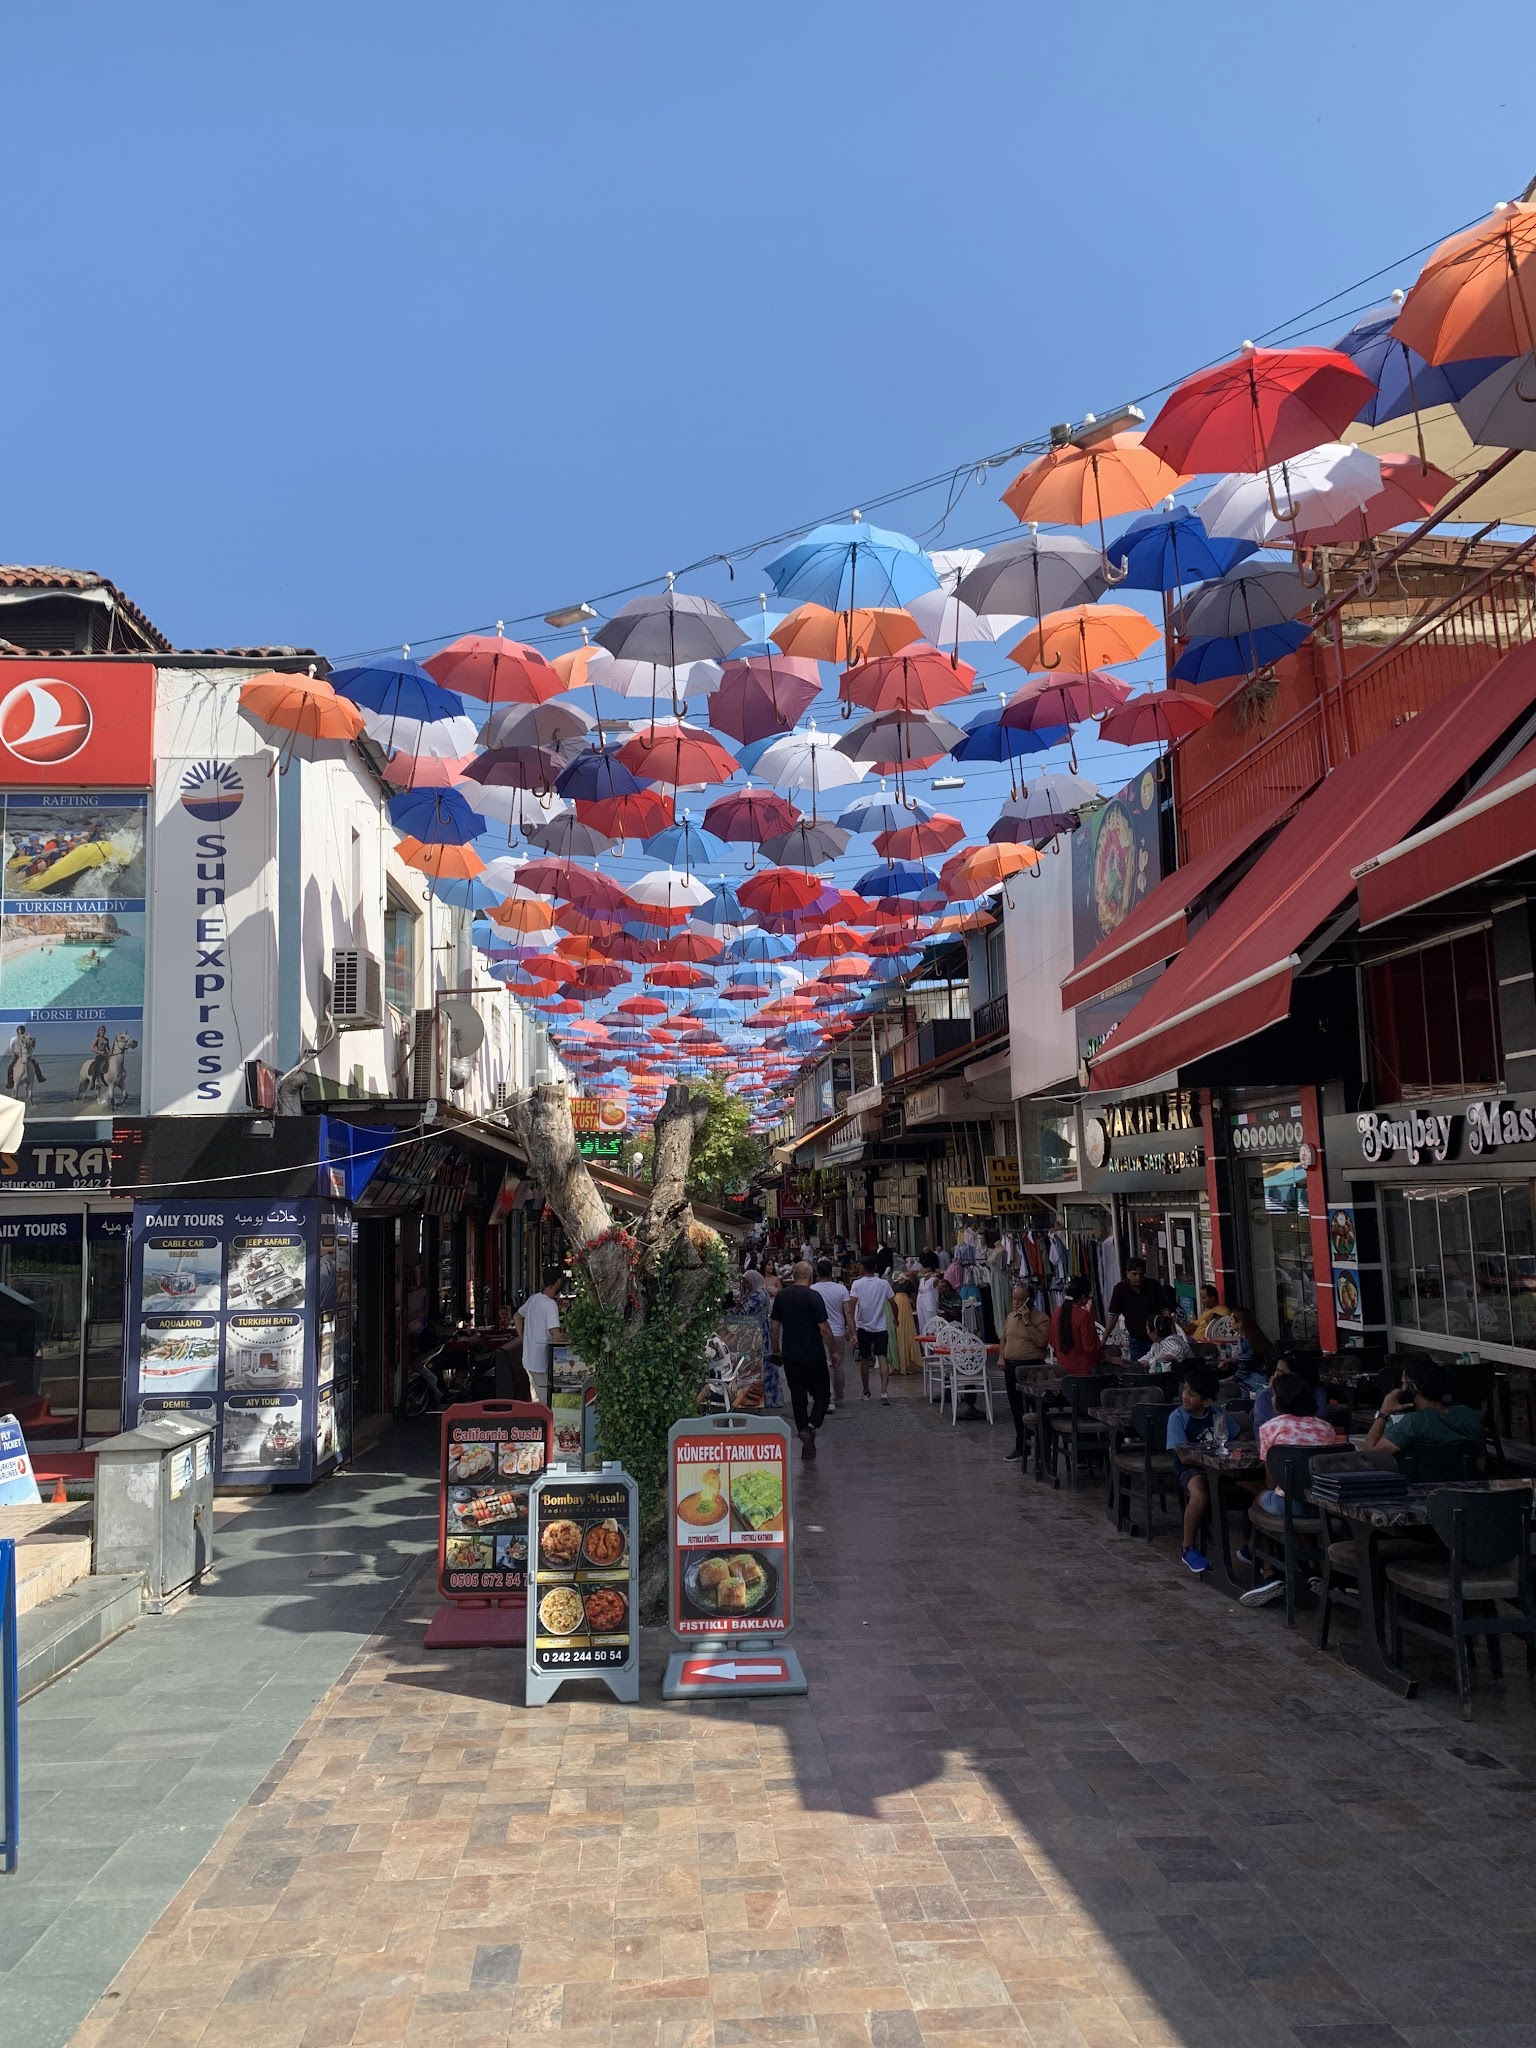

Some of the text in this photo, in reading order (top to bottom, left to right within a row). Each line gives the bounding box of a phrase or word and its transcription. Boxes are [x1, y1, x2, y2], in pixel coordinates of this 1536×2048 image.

[42, 796, 99, 806] RAFTING
[16, 901, 72, 912] TURKISH
[30, 1009, 106, 1020] HORSE RIDE
[580, 1116, 600, 1128] USTA
[1103, 1104, 1194, 1137] VAKIFLAR
[1356, 1110, 1453, 1165] Bombay
[73, 1179, 101, 1189] 0242
[145, 1213, 224, 1228] DAILY TOURS
[267, 1209, 306, 1226] رحلات
[0, 1223, 67, 1238] ILY TOURS
[162, 1239, 204, 1248] CABLE CAR
[245, 1237, 291, 1248] JEEP SAFARI
[159, 1319, 202, 1328] AQUALAND
[238, 1317, 293, 1326] TURKISH BATH
[162, 1400, 190, 1409] DEMRE
[246, 1397, 280, 1407] ATV TOUR
[453, 1427, 543, 1441] California Sushi
[677, 1442, 783, 1462] KÜNEFECİ TARIK USTA
[541, 1491, 626, 1508] Bombay Masala
[450, 1573, 479, 1588] 0505
[481, 1573, 504, 1587] 672
[505, 1573, 521, 1587] 54
[680, 1619, 785, 1631] FISTIKLI BAKLAVA
[543, 1650, 622, 1663] 0 242 244 50 54
